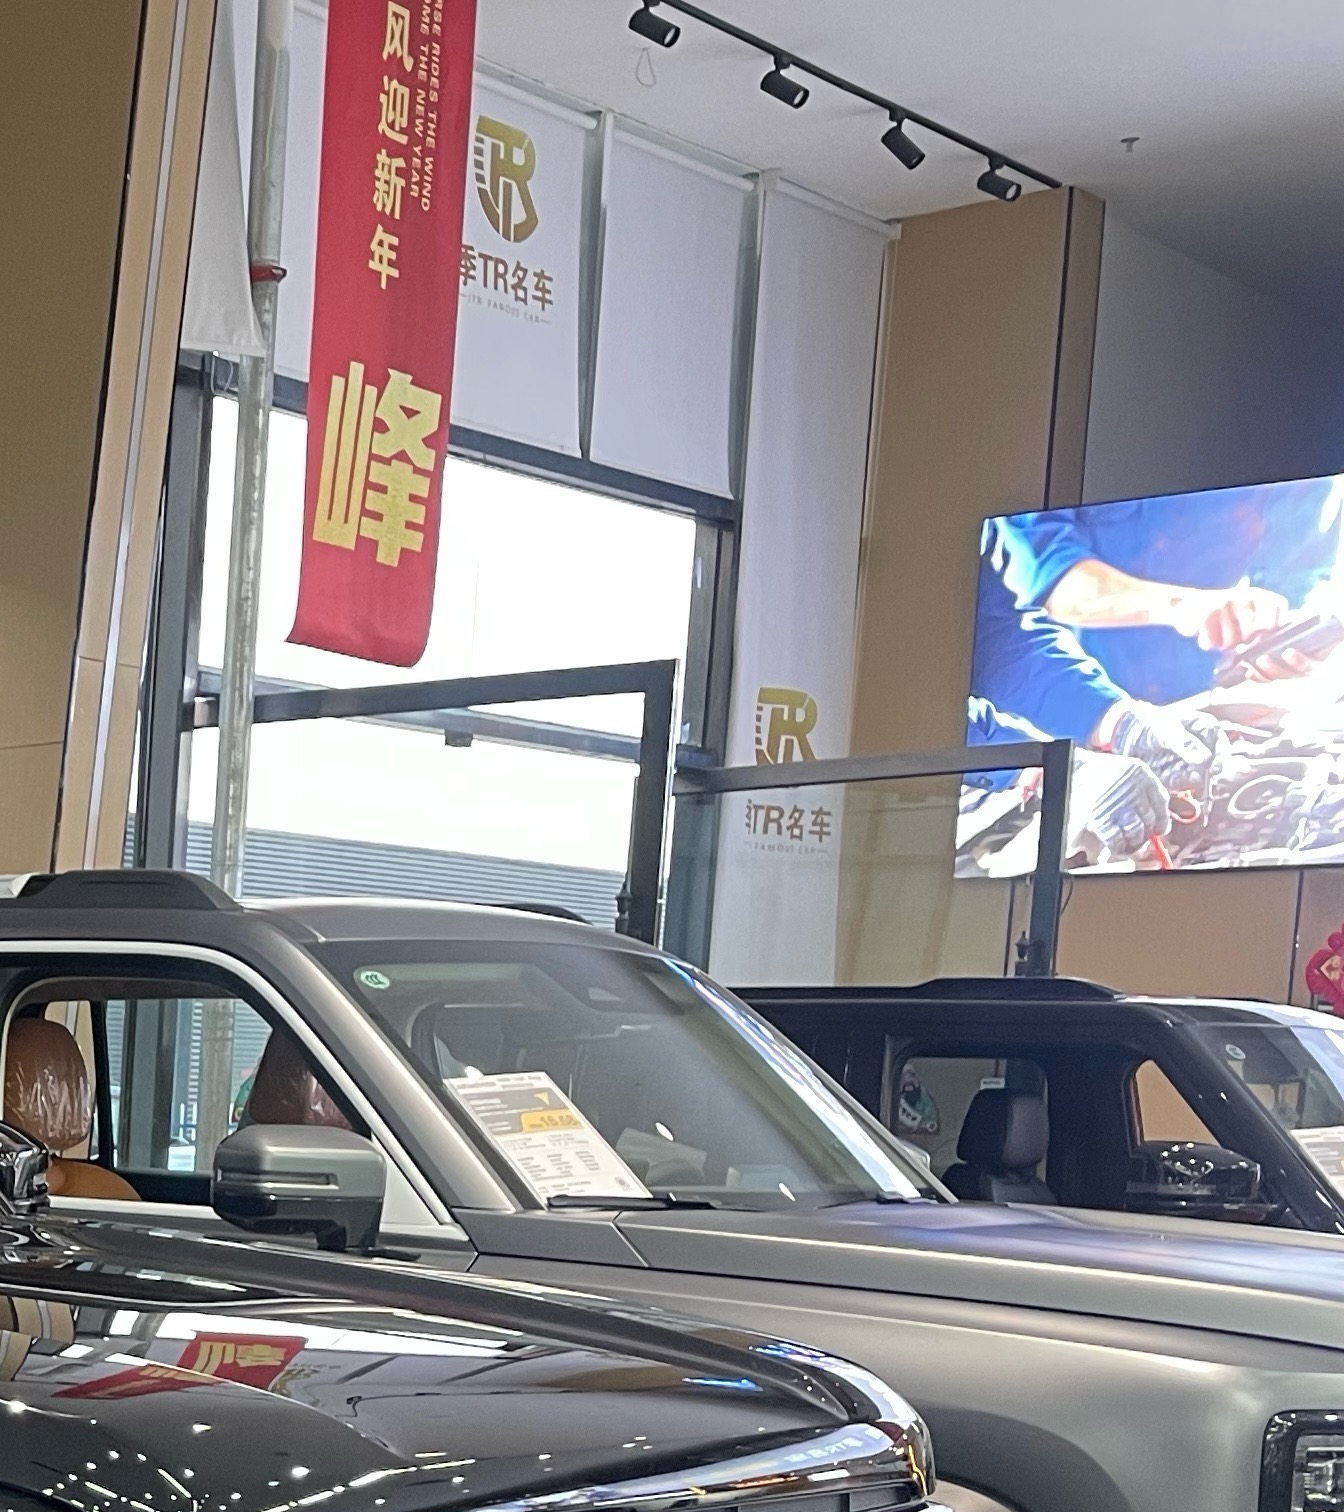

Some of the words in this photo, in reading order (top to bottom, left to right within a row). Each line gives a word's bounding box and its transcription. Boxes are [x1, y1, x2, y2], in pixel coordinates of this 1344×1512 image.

[417, 43, 429, 82] THE
[429, 42, 441, 103] RIDES
[415, 87, 427, 138] NEW
[426, 110, 438, 149] THE
[369, 0, 413, 290] 风迎新年
[410, 145, 422, 198] YEAR
[421, 157, 434, 212] WIND
[312, 361, 443, 567] 峰
